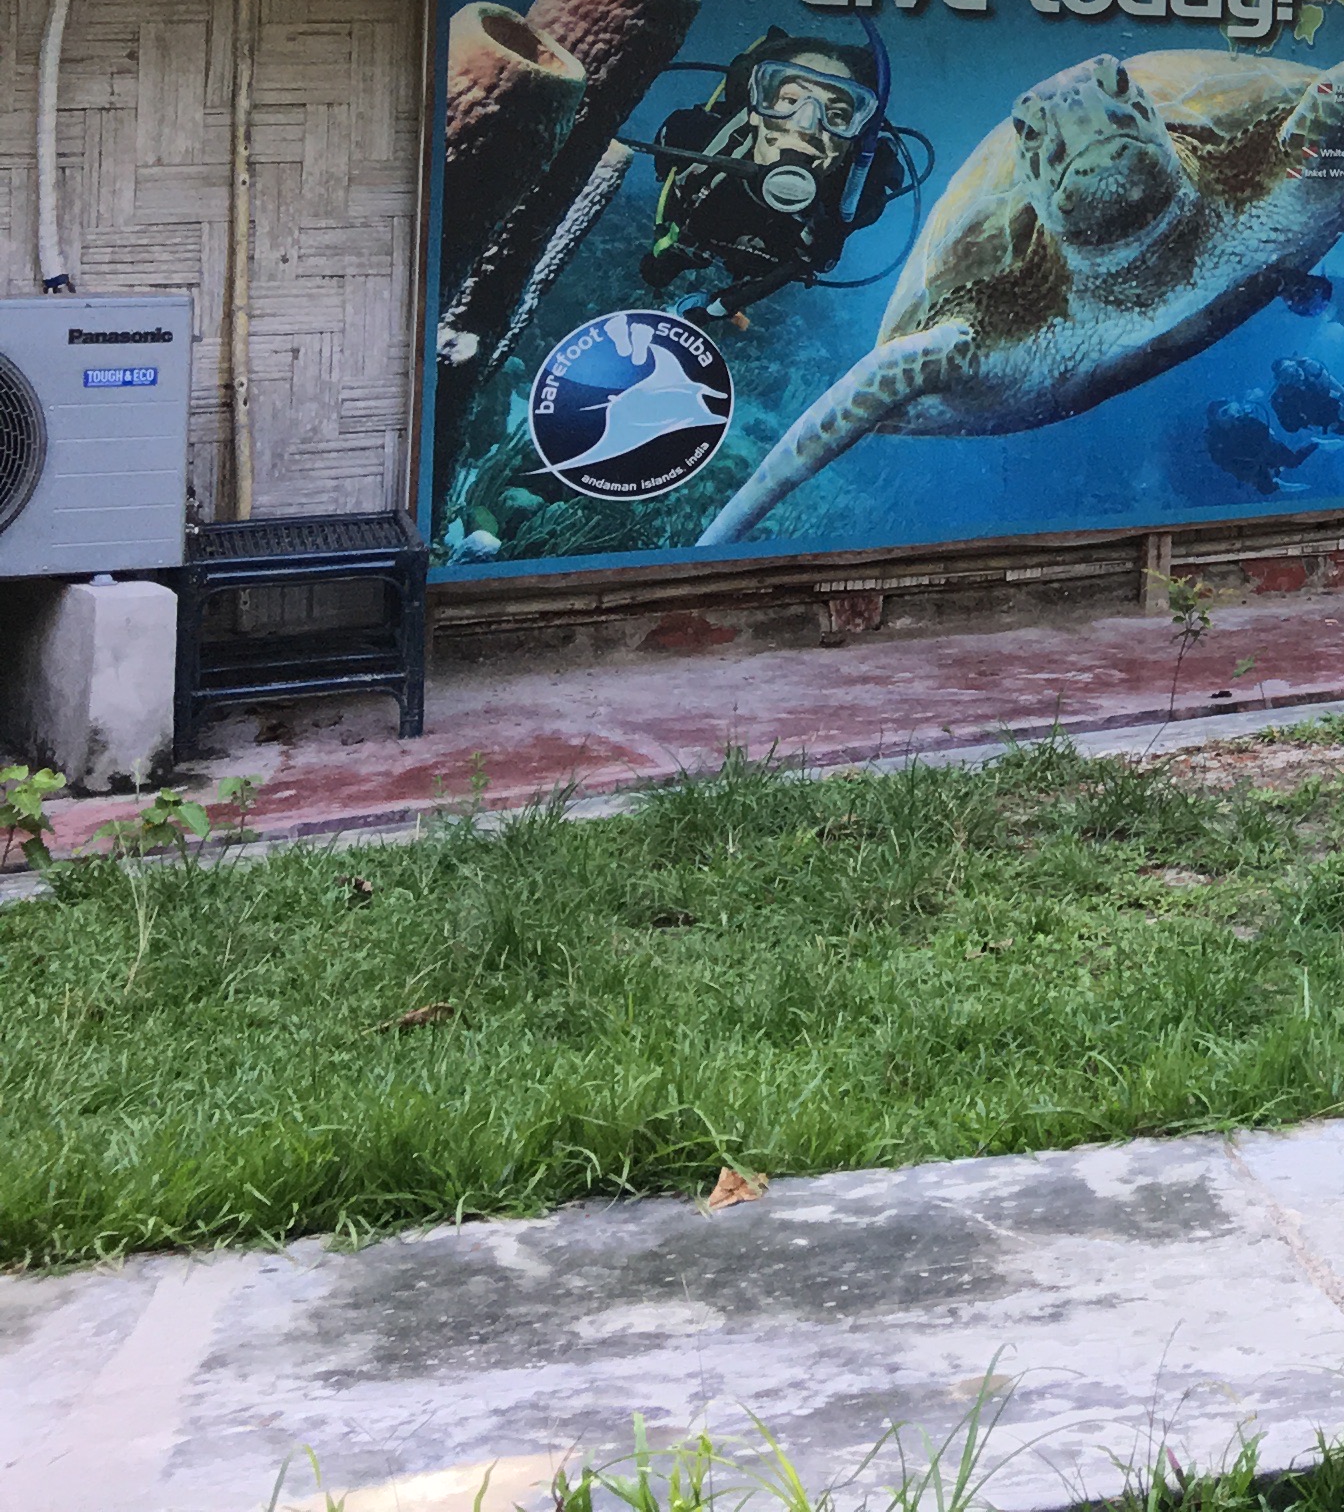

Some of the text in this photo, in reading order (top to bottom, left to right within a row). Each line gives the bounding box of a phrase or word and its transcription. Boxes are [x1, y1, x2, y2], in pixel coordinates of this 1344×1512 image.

[68, 327, 173, 345] Panasonic
[535, 322, 714, 415] barefoot scuba
[581, 473, 637, 492] andaman
[685, 442, 710, 467] india
